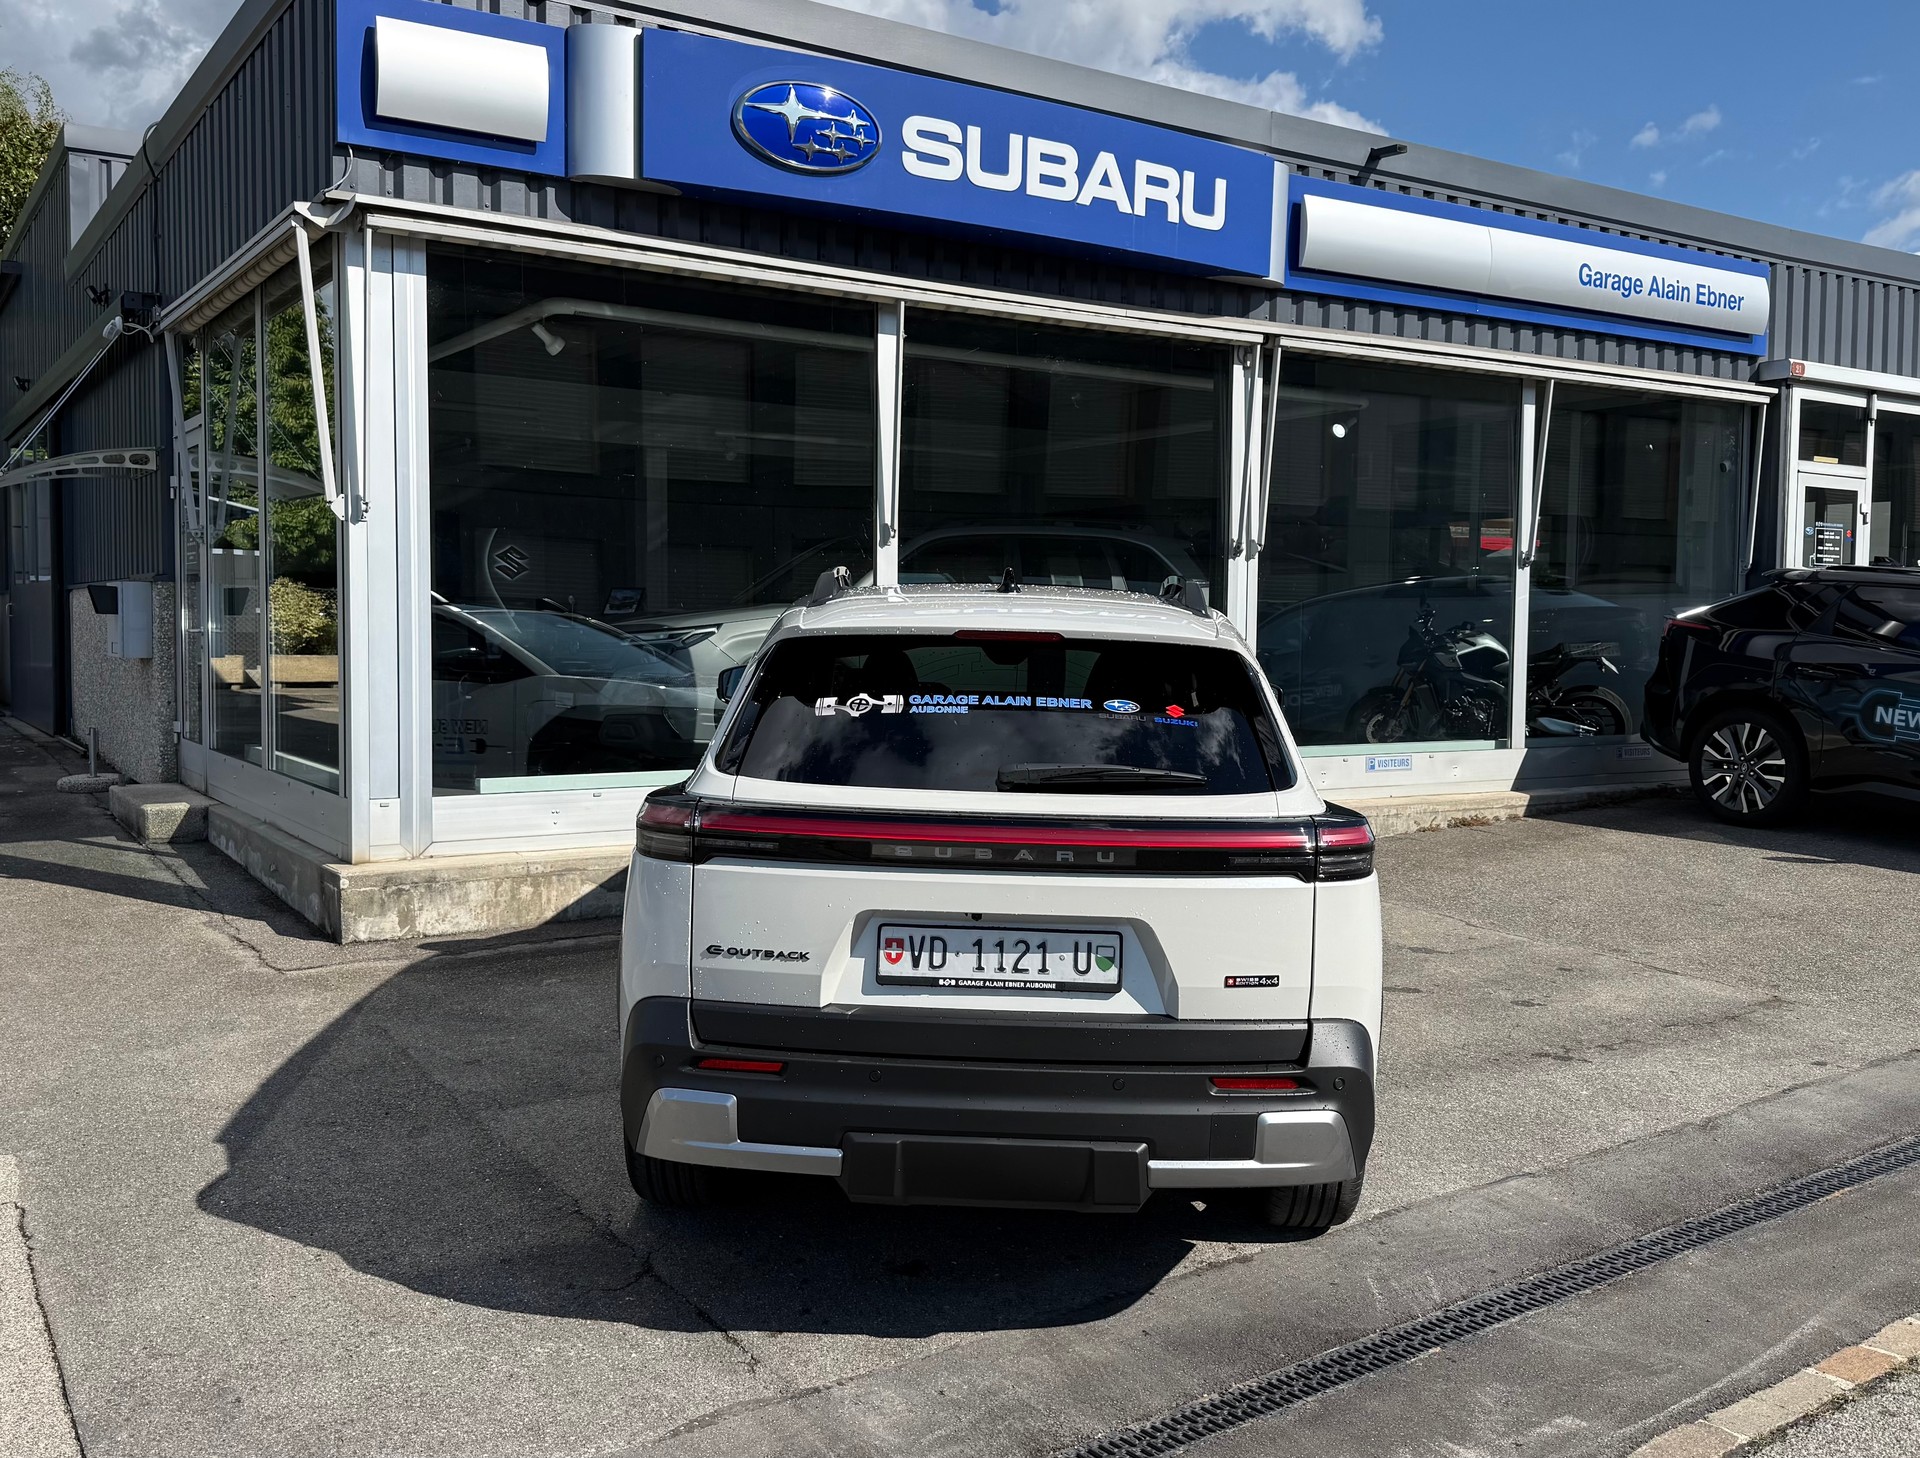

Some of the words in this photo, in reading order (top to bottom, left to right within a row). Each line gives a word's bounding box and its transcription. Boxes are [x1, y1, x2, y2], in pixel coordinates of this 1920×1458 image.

[901, 114, 1227, 231] SUBARU
[1578, 262, 1644, 299] Garage
[1648, 275, 1691, 303] Alain
[1695, 282, 1745, 312] Ebner
[908, 694, 979, 705] GARAGE
[981, 695, 1032, 706] ALAIN
[1036, 696, 1093, 710] EBNER
[909, 705, 969, 714] AUBONNE
[1098, 712, 1147, 722] SUBARU
[1154, 716, 1199, 727] SUZUKI
[1377, 758, 1410, 768] VISITEURS
[894, 844, 1115, 863] SUBARU
[908, 934, 948, 970] VD
[972, 937, 1050, 974] 1121
[1072, 940, 1093, 976] U
[985, 980, 1004, 988] ALAIN
[1025, 981, 1056, 989] AUBONNE
[1260, 977, 1278, 985] 4x4
